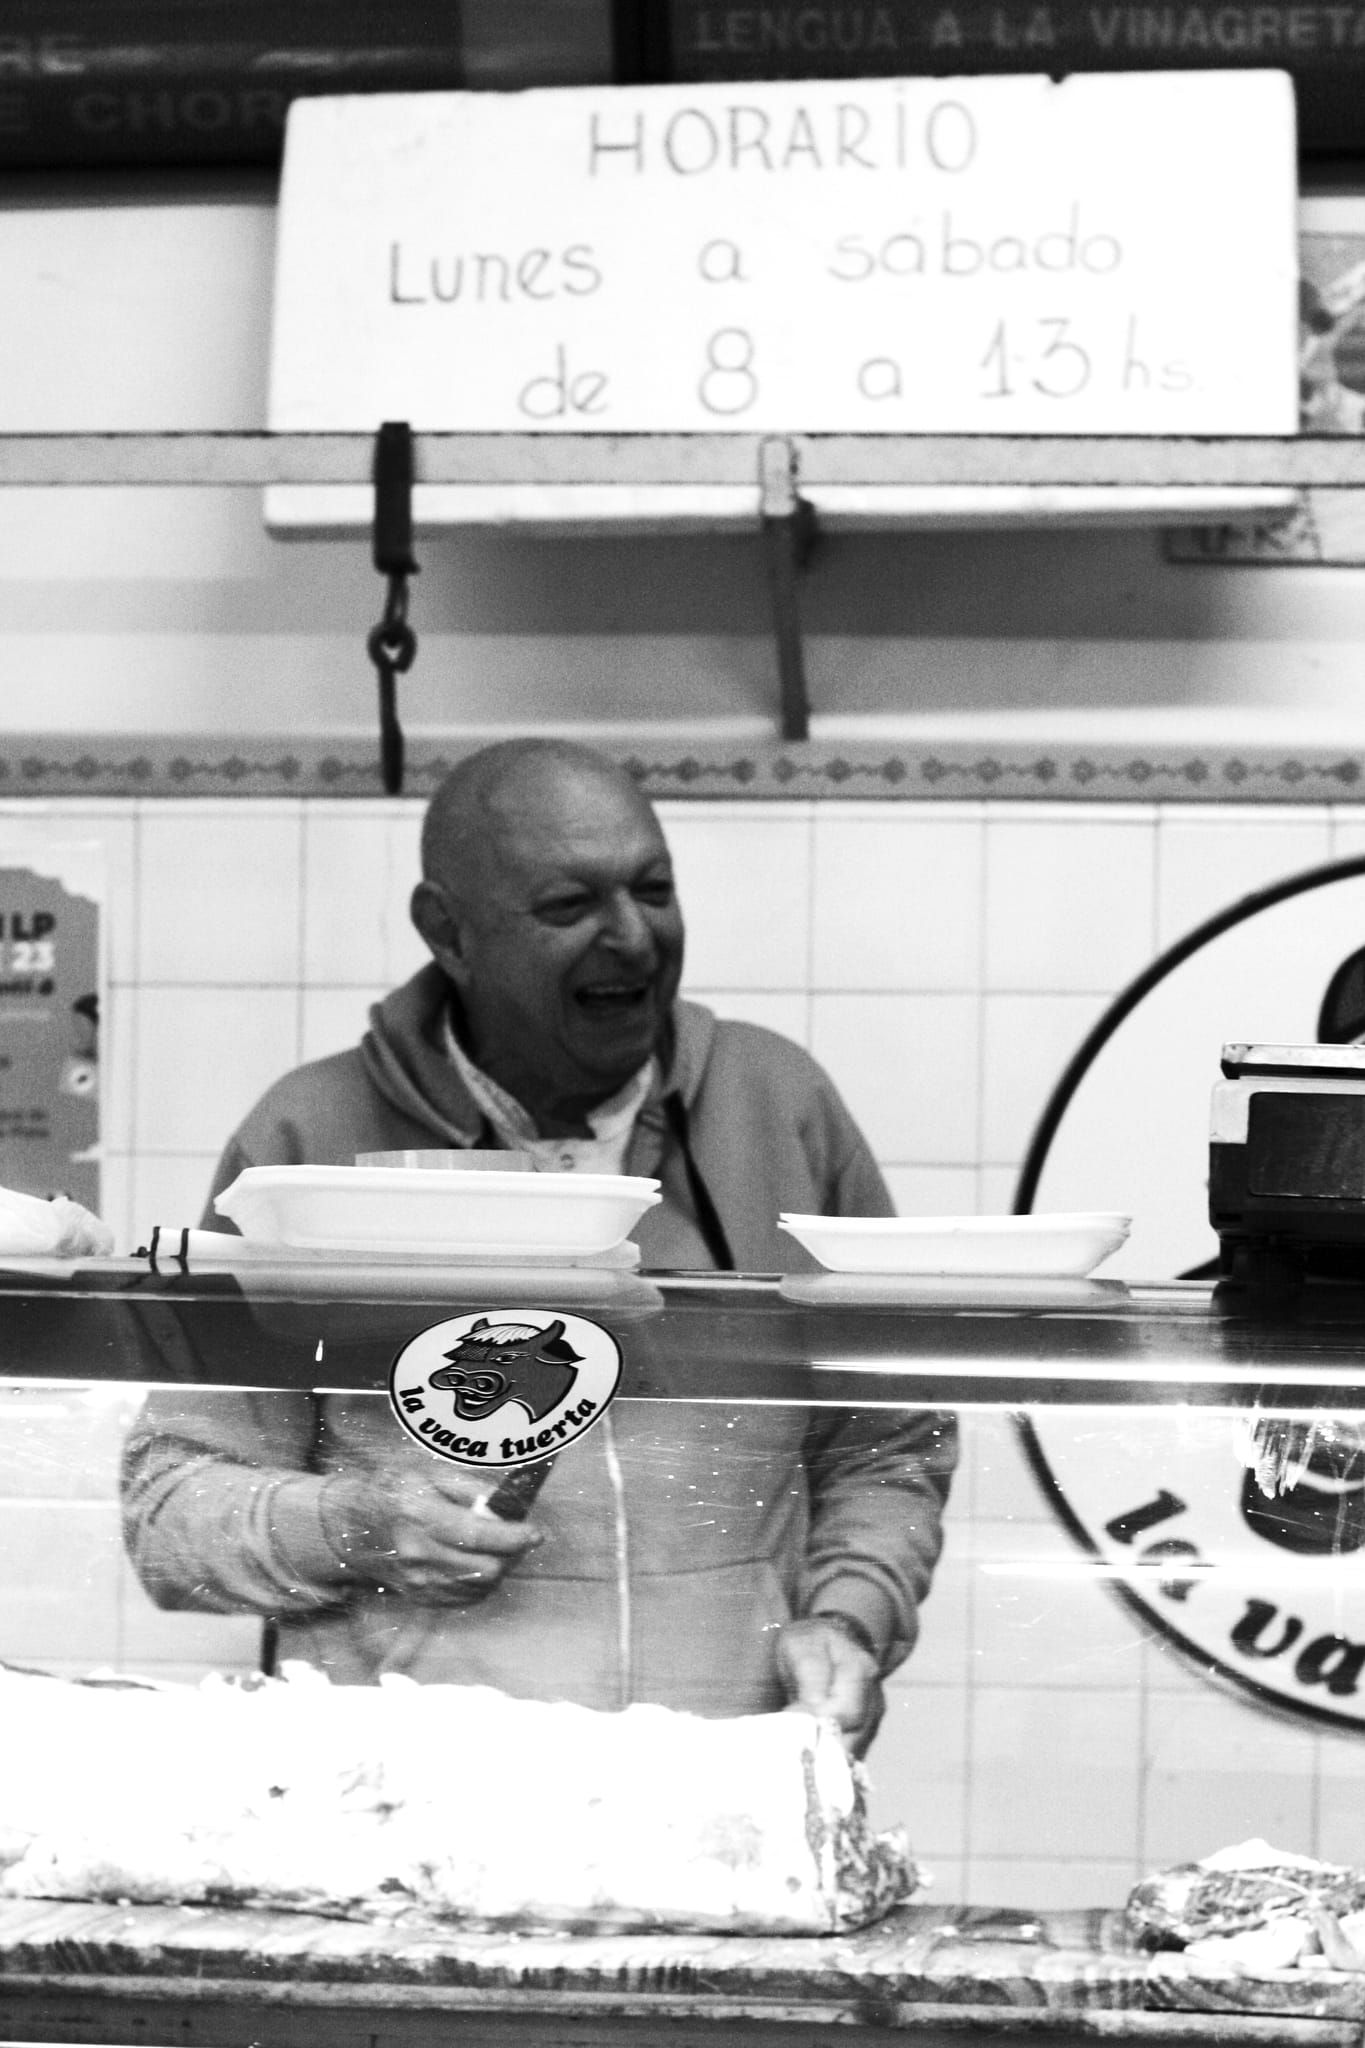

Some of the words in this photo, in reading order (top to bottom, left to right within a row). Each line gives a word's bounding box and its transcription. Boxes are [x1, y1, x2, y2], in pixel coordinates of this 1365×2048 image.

[696, 8, 898, 51] LENGUA
[932, 10, 962, 47] A
[991, 8, 1055, 48] LA
[588, 98, 978, 176] HORARIO
[389, 242, 602, 304] Lunes
[698, 238, 748, 284] a
[827, 200, 1123, 282] sábado
[518, 343, 609, 419] de
[699, 327, 758, 416] 8
[857, 356, 903, 401] a
[980, 316, 1091, 398] 13
[398, 1386, 425, 1413] la
[419, 1418, 489, 1457] vaca
[500, 1398, 596, 1459] tuerta
